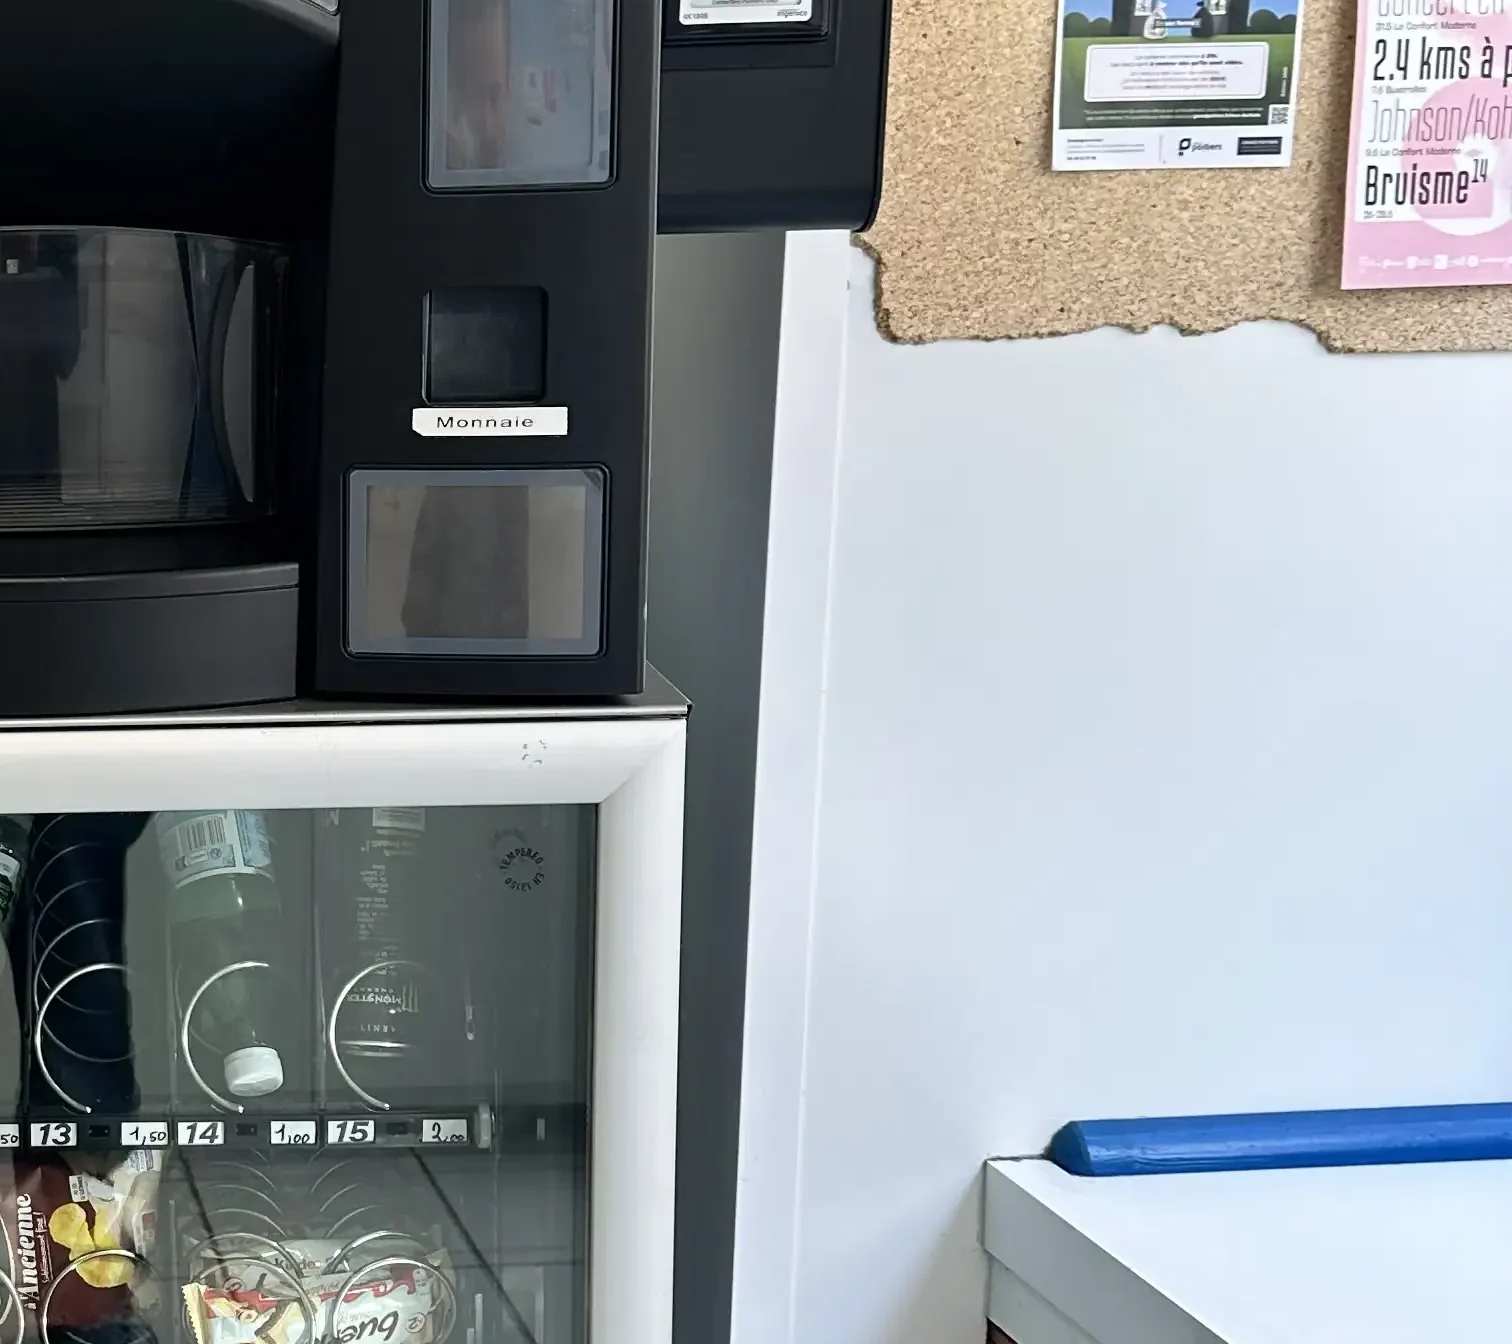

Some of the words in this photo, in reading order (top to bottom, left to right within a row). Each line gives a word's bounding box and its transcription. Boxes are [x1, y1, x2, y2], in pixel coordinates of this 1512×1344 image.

[1373, 38, 1410, 81] 2.4
[1419, 36, 1471, 81] kms
[1480, 36, 1493, 79] à
[437, 416, 534, 429] Monnaie
[38, 1124, 72, 1144] 13
[185, 1123, 220, 1144] 14
[333, 1121, 370, 1142] 15
[24, 1301, 37, 1311] à
